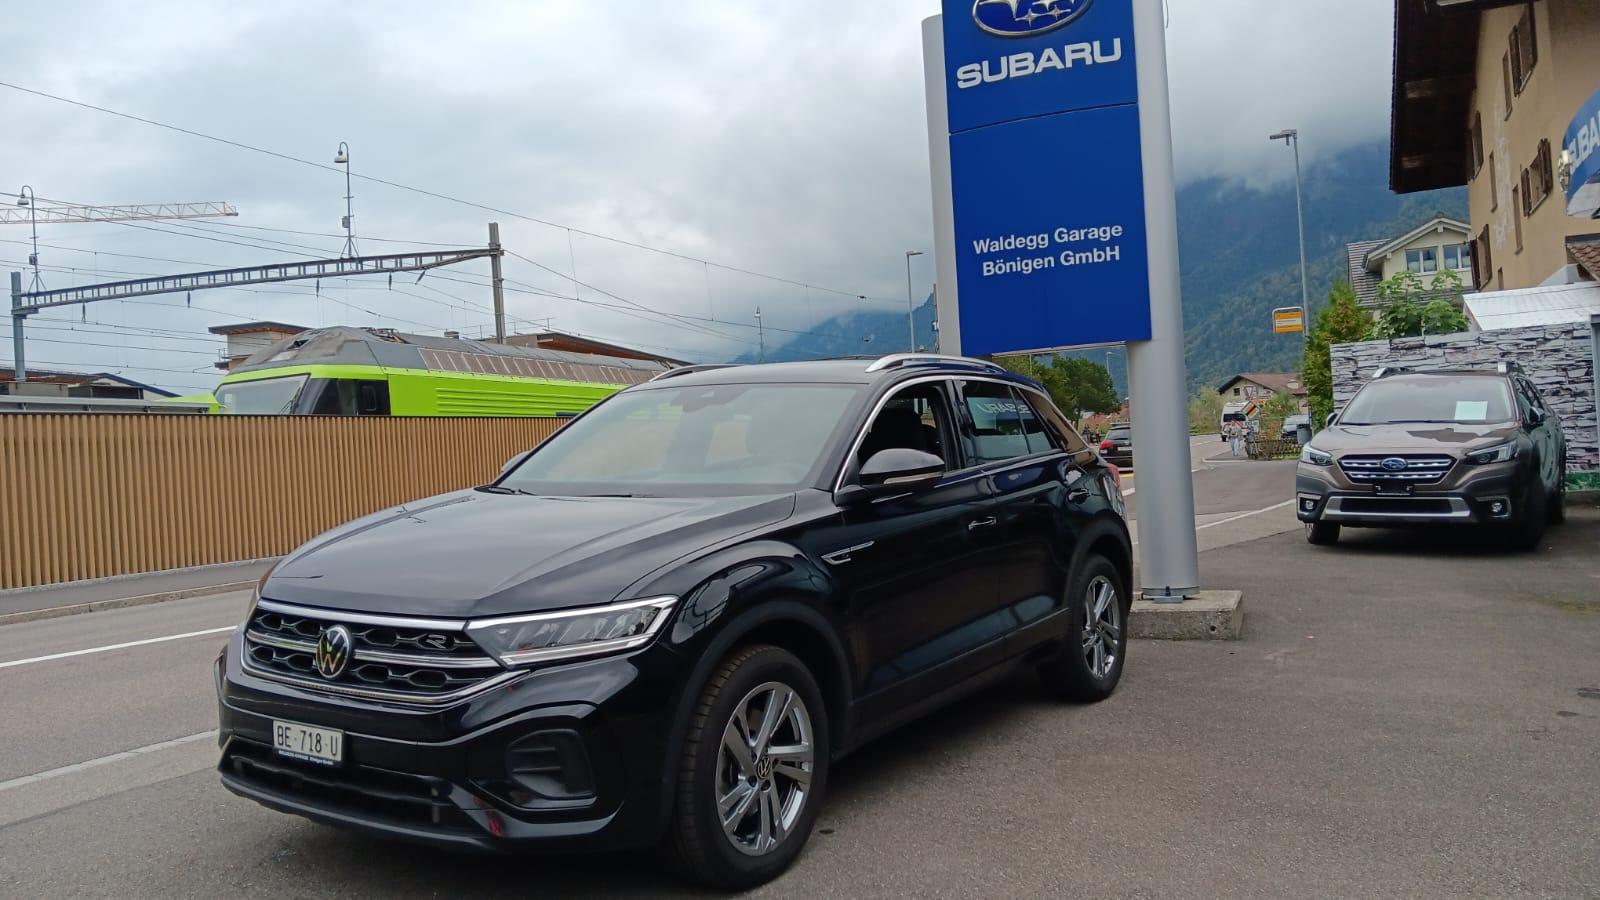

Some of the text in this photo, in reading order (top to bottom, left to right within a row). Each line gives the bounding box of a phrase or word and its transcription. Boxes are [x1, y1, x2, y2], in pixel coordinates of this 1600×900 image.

[956, 37, 1122, 89] SUBARU
[1567, 110, 1600, 175] SUBA
[973, 225, 1123, 254] Waldegg Garage
[982, 245, 1120, 276] Bönigen GmbH
